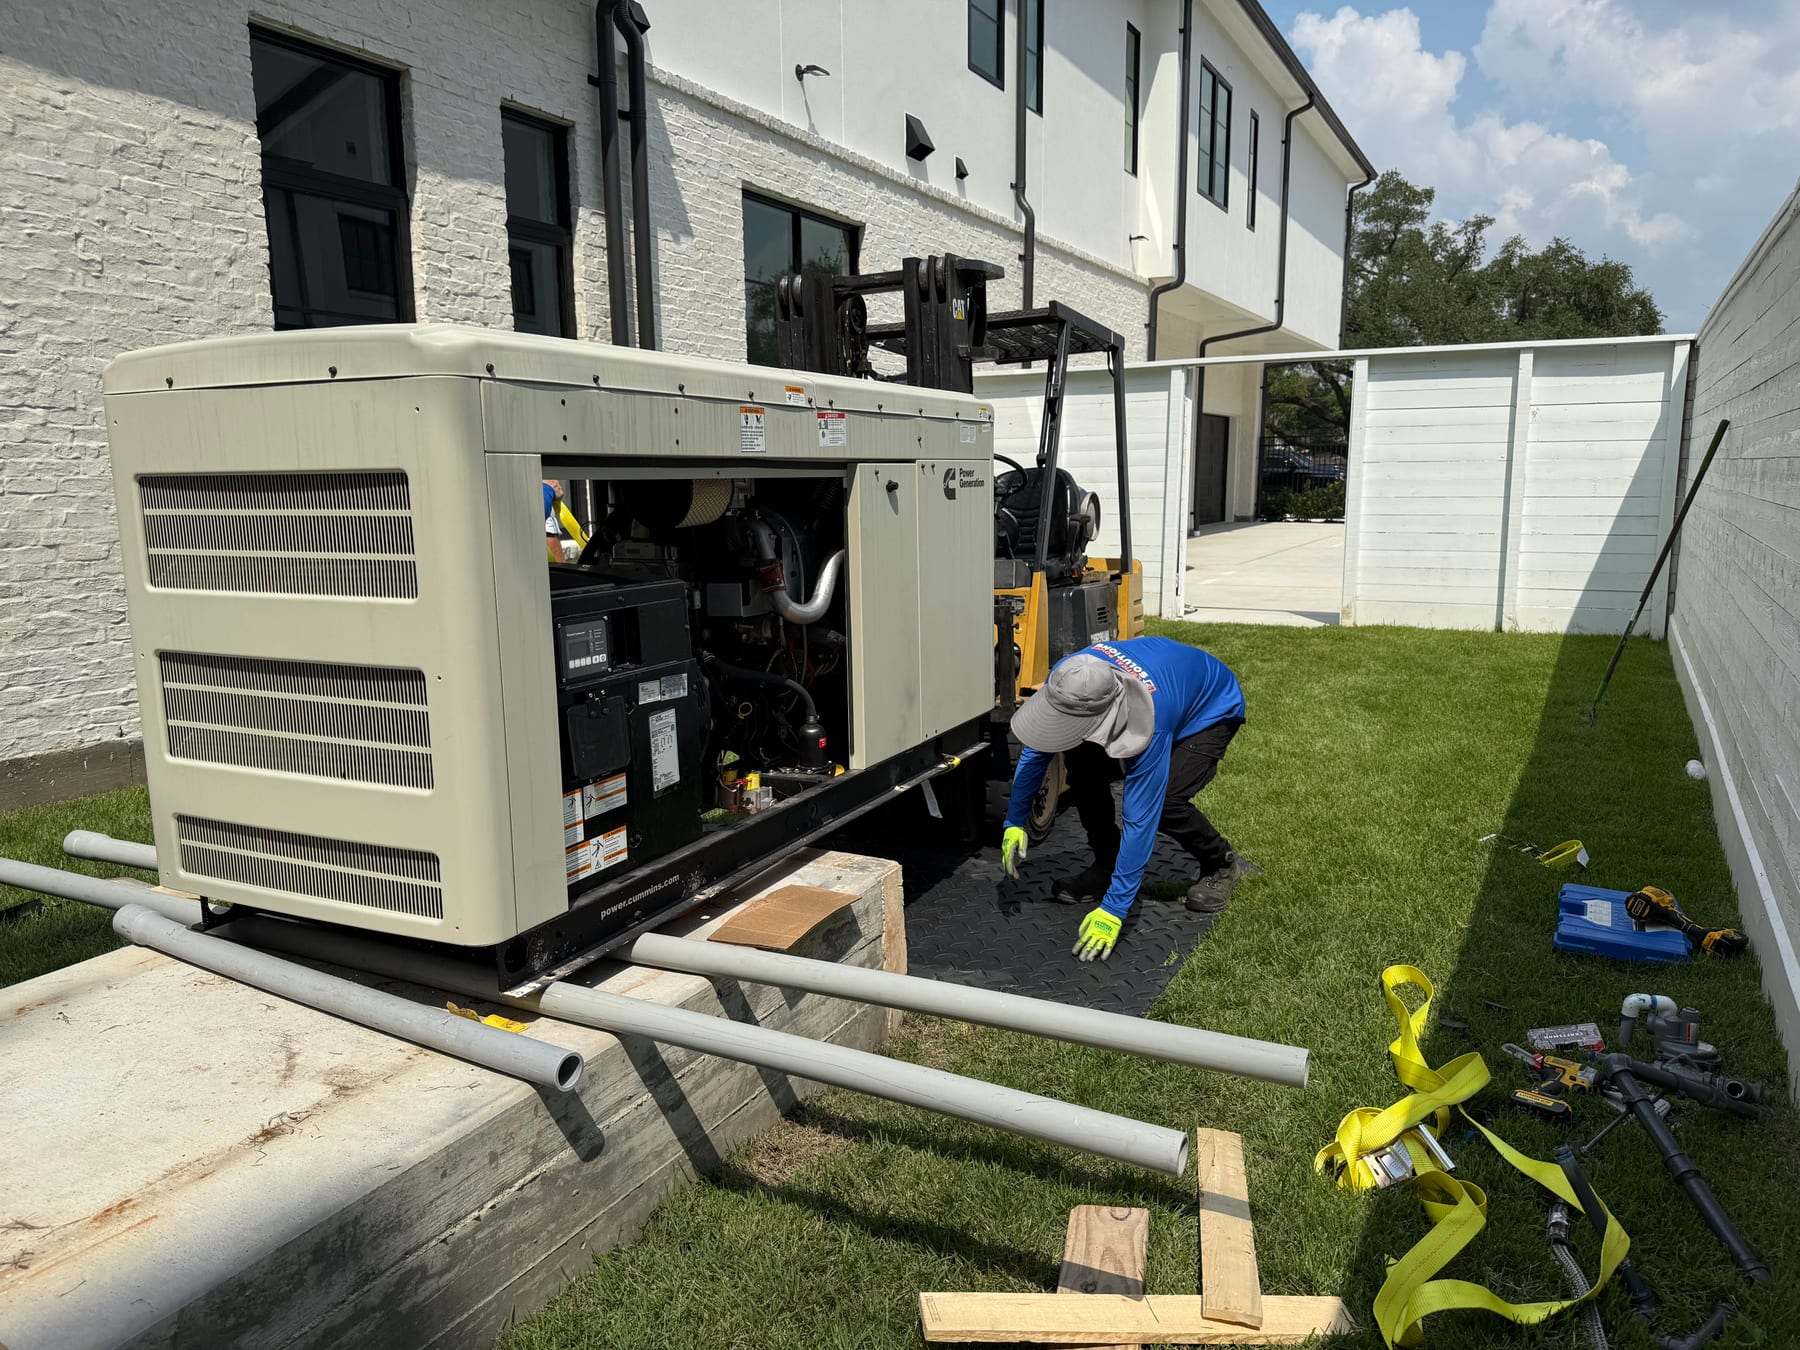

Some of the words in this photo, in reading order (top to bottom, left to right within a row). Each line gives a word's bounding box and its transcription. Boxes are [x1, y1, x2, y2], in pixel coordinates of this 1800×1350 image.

[952, 298, 965, 320] CAT
[960, 468, 975, 478] Power
[960, 478, 985, 489] Generation
[601, 874, 680, 920] power.cummins.com
